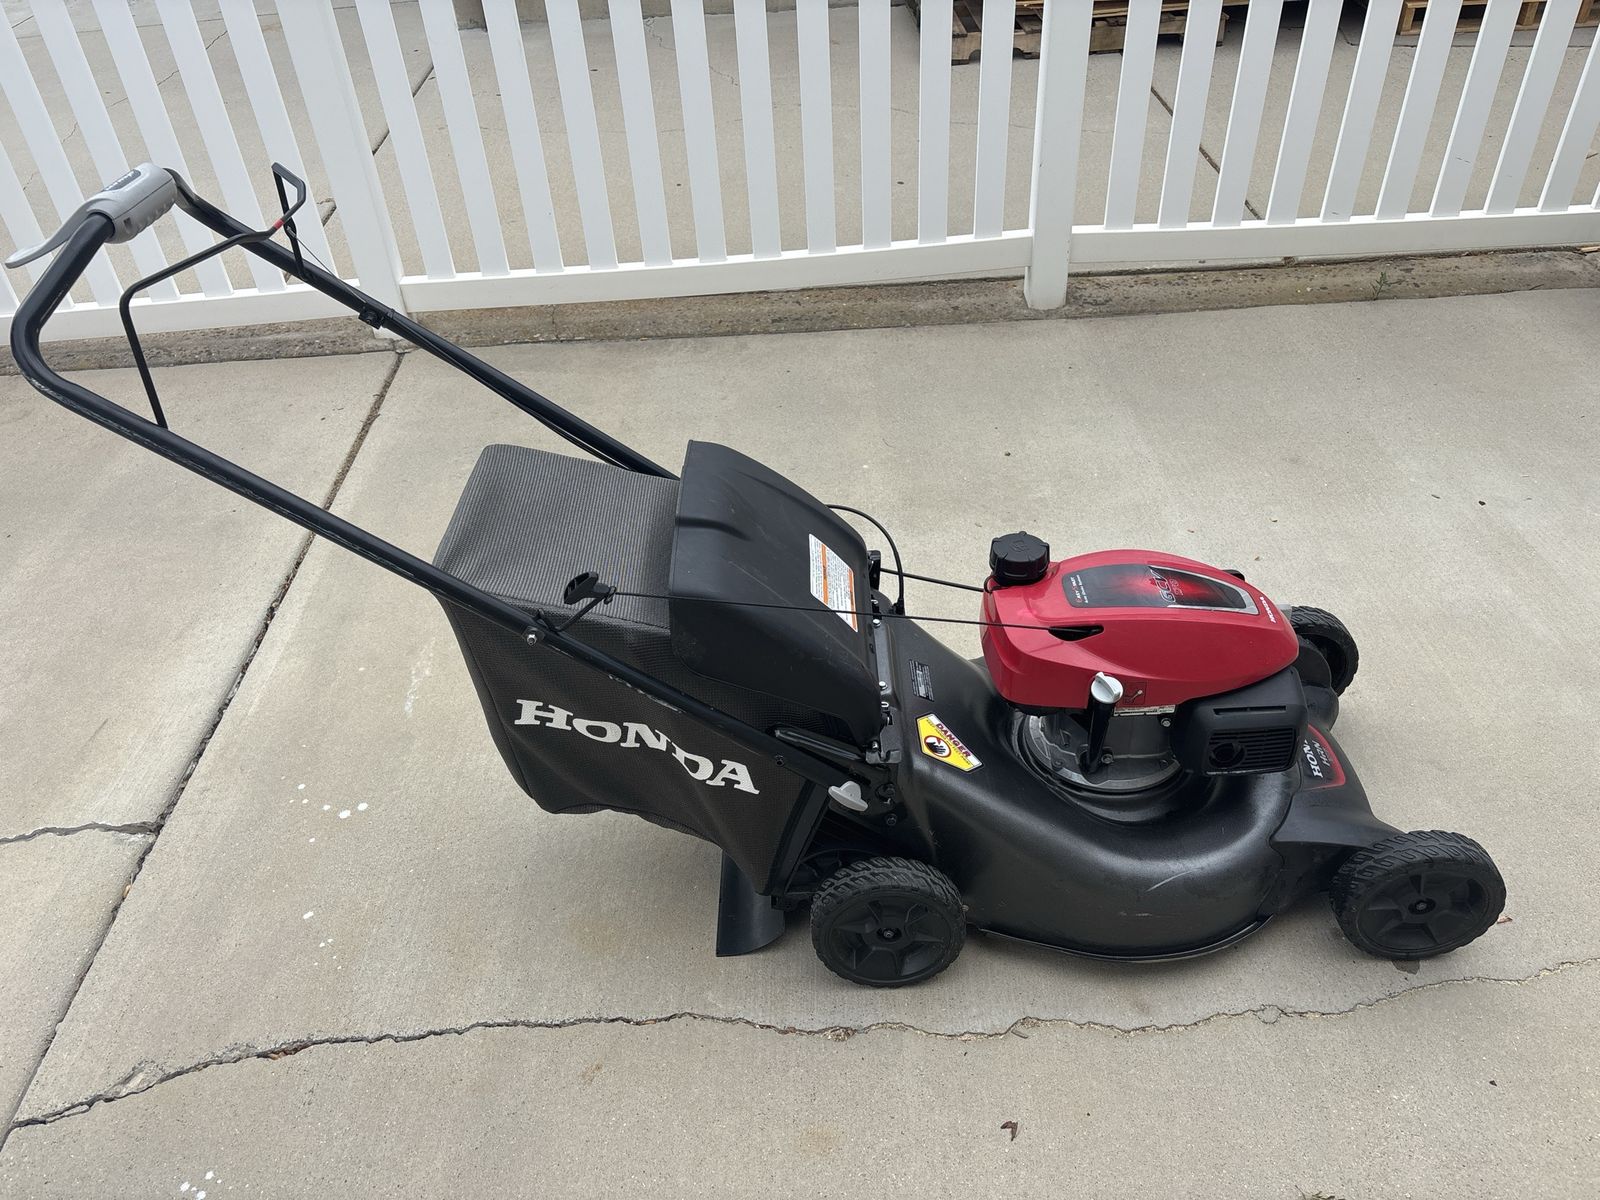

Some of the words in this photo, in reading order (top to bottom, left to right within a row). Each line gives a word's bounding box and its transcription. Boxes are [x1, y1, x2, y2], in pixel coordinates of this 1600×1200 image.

[514, 698, 760, 795] HONDA
[936, 723, 971, 757] DANGER
[1303, 739, 1324, 778] HON
